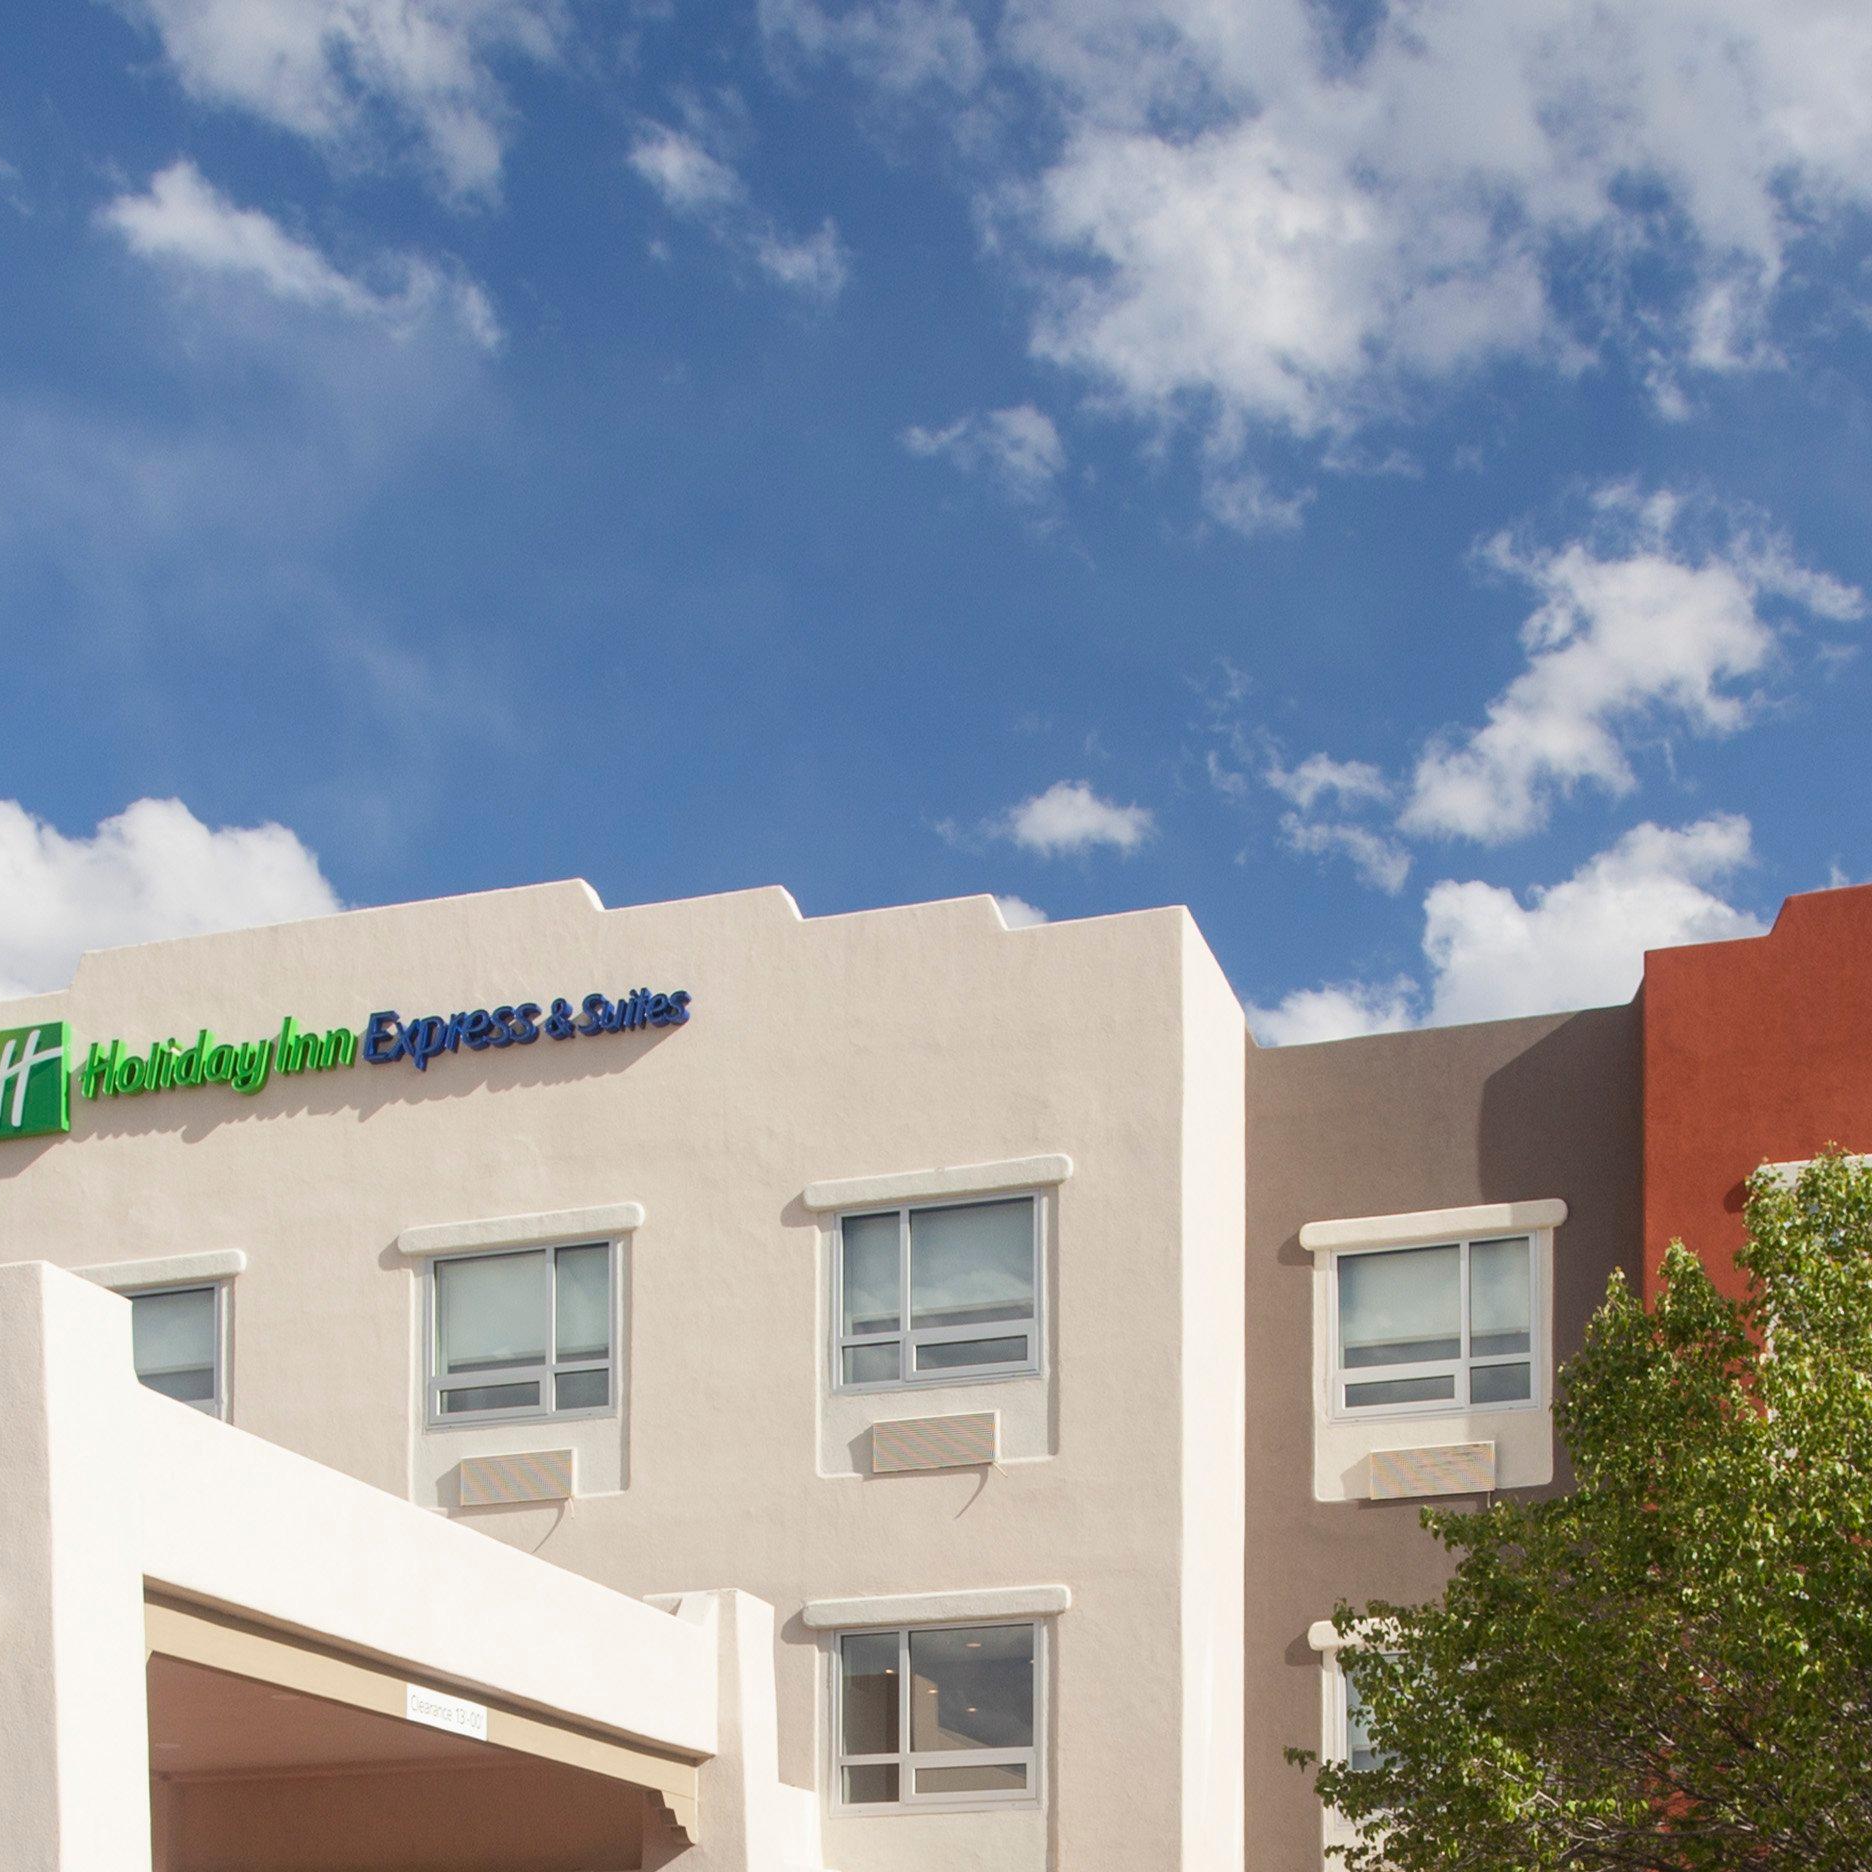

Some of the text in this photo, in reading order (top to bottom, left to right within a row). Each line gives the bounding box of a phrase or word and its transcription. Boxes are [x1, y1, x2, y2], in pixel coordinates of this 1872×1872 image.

[78, 987, 692, 1096] Holiday Inn Express & Suites
[410, 1693, 453, 1722] Clearance
